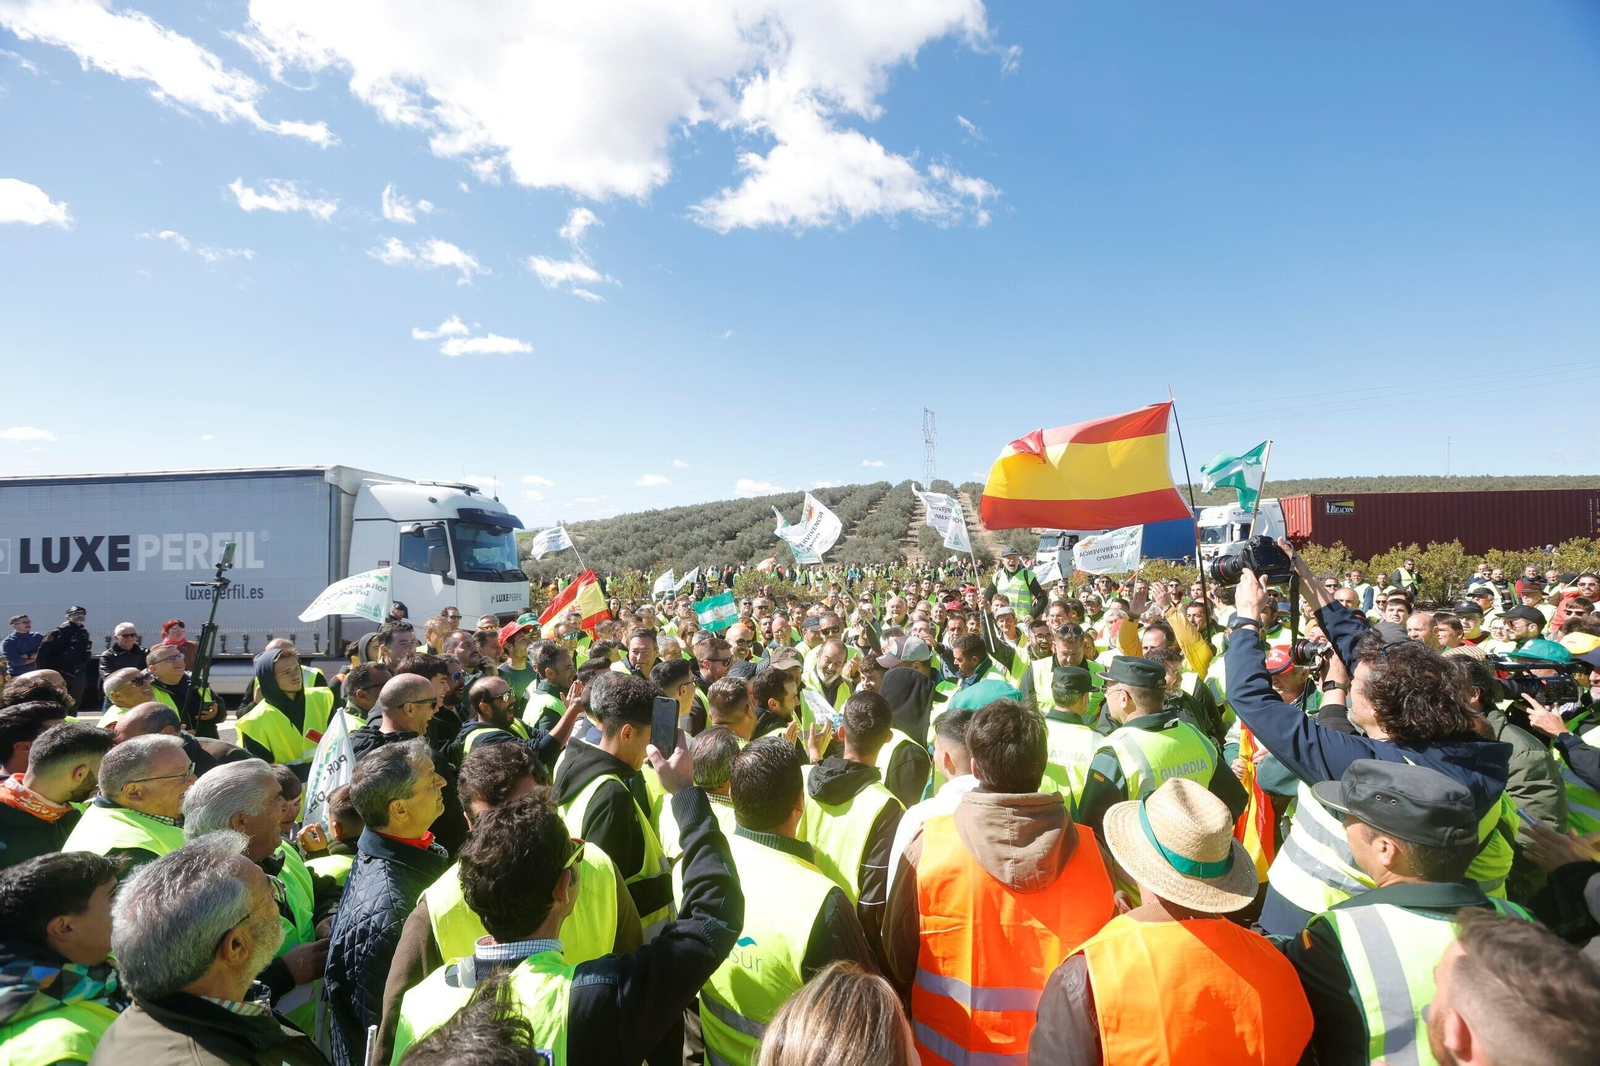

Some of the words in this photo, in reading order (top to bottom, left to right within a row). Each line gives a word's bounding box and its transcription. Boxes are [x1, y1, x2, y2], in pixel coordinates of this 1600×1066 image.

[20, 535, 130, 573] LUXE
[138, 531, 264, 571] PERFIL
[496, 594, 509, 603] LUXE
[1049, 749, 1087, 763] ARDIA
[1160, 758, 1208, 781] GUARDIA
[730, 947, 762, 973] sur
